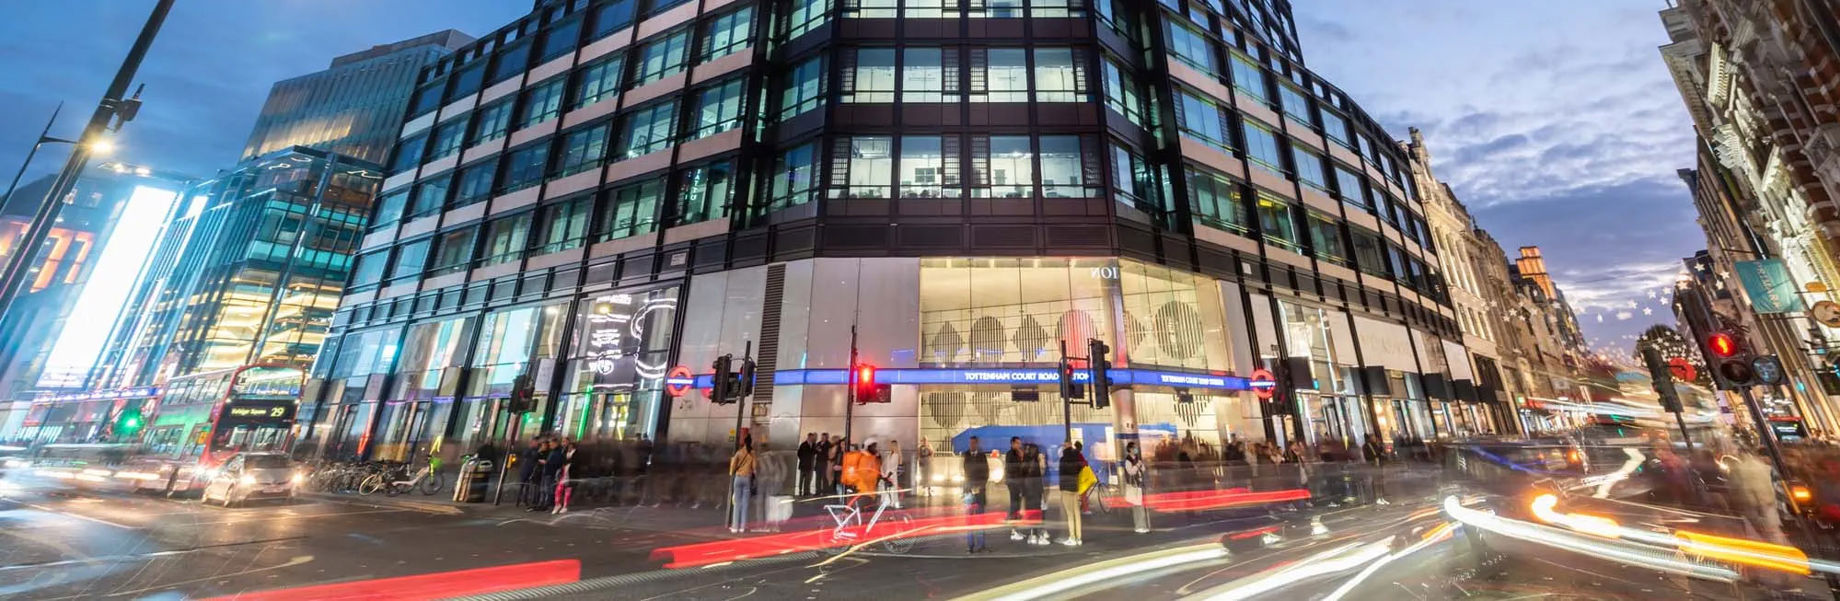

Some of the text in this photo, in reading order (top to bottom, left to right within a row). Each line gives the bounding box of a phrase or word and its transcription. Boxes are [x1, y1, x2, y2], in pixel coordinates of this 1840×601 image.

[964, 372, 1010, 381] TOTTENHAM
[1011, 372, 1037, 381] COURT
[1038, 372, 1060, 381] ROAD
[270, 406, 285, 417] 29
